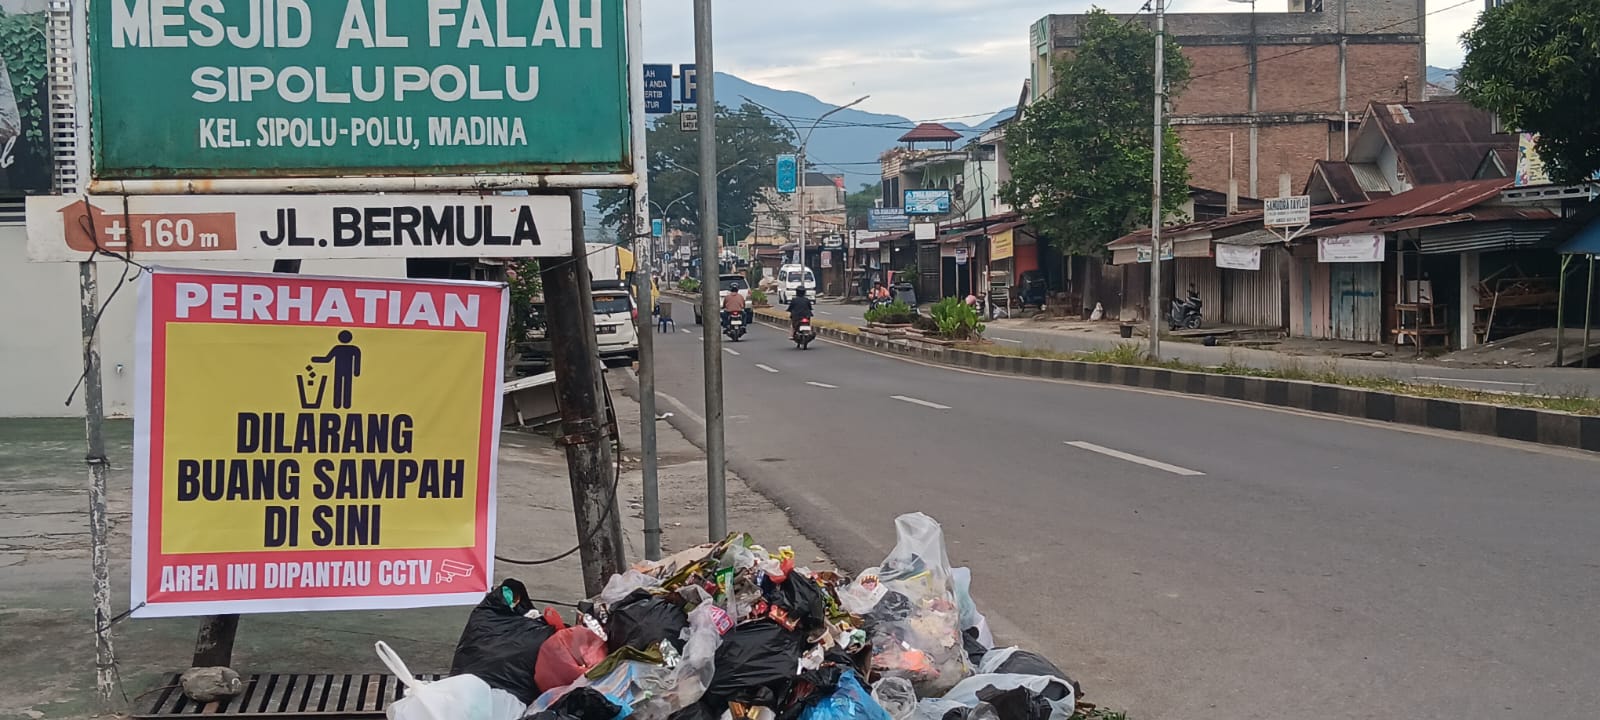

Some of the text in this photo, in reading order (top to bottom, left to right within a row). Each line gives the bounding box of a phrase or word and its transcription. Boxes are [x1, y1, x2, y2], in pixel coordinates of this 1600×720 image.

[111, 0, 603, 49] MESJID AL FALAH
[645, 90, 662, 98] ERTIB
[650, 80, 667, 88] ANDA
[199, 116, 528, 150] KEL. SIPOLU-POLU, MADINA
[141, 218, 195, 247] 160
[199, 232, 219, 248] m
[175, 282, 480, 328] PERHATIAN
[236, 412, 414, 454] DILARANG
[177, 458, 465, 502] BUANG SAMPAH
[263, 504, 381, 548] DI SINI
[160, 559, 433, 593] AREA INI DIPANTAU CCTV
